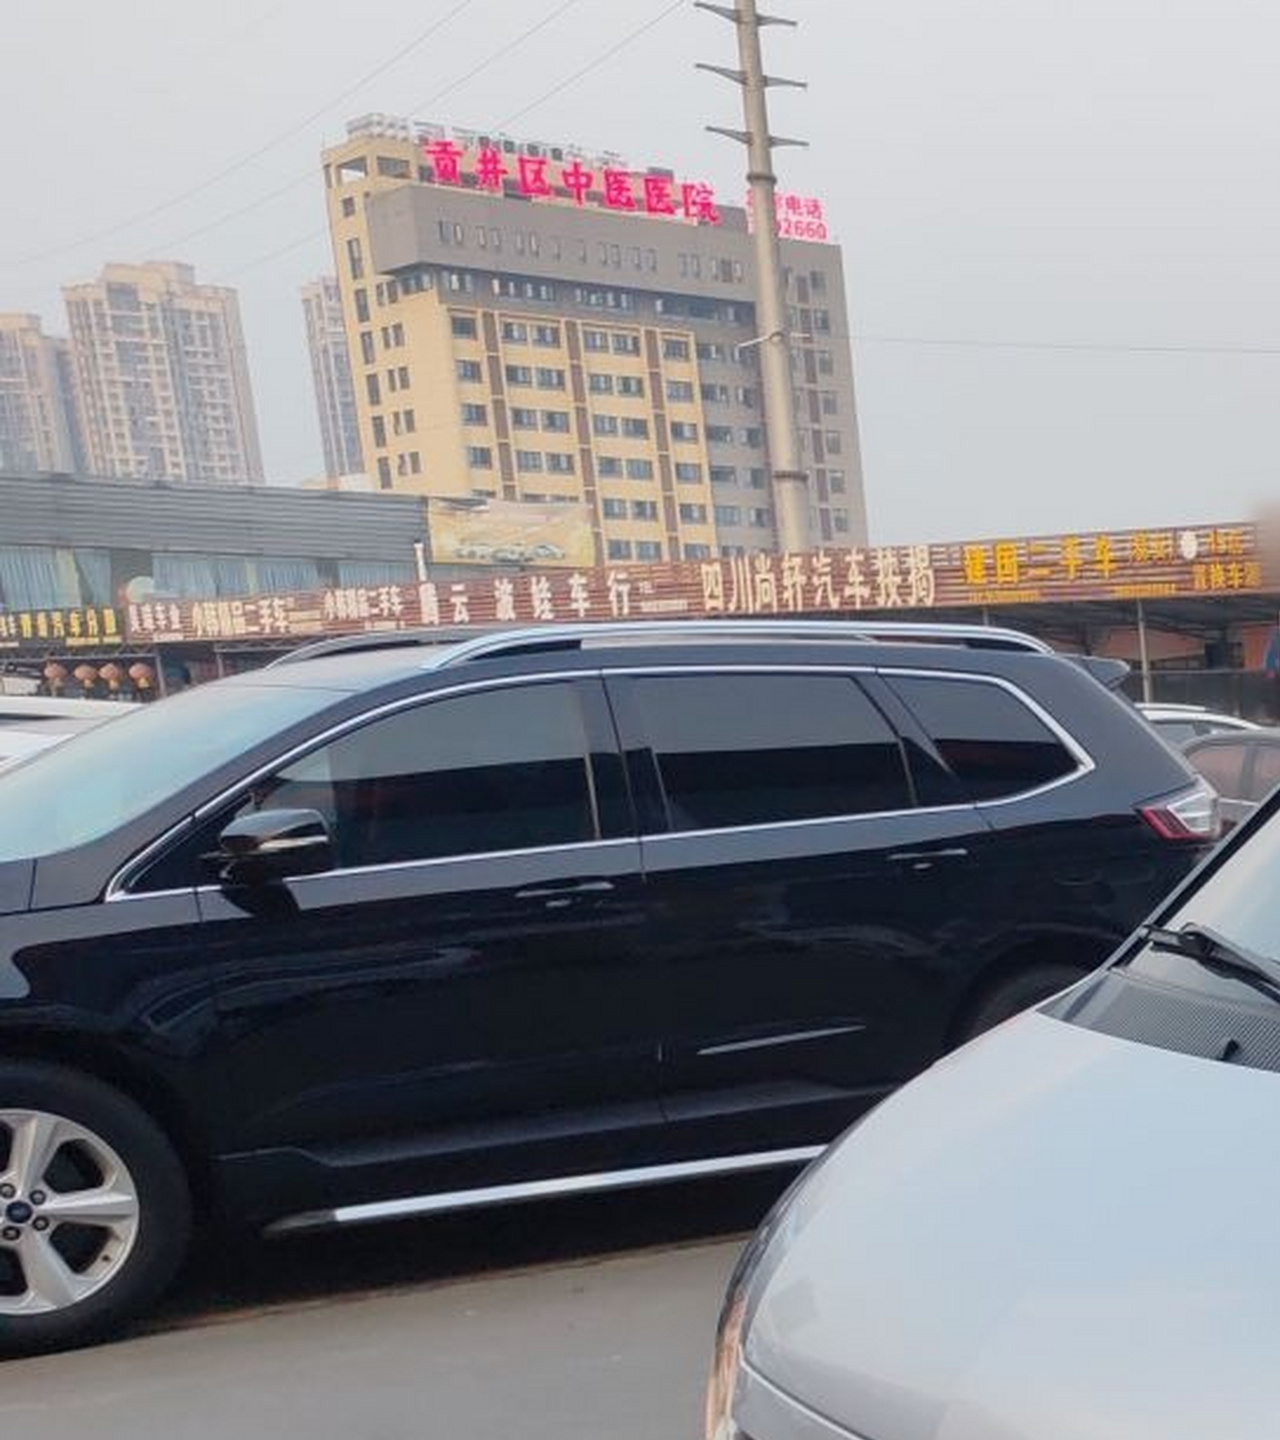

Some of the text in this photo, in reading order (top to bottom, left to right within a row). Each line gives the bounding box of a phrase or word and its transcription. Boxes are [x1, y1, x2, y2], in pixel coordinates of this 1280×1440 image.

[426, 141, 720, 225] 贡井区中医医院
[701, 545, 934, 613] 四川尚轩汽车按揭
